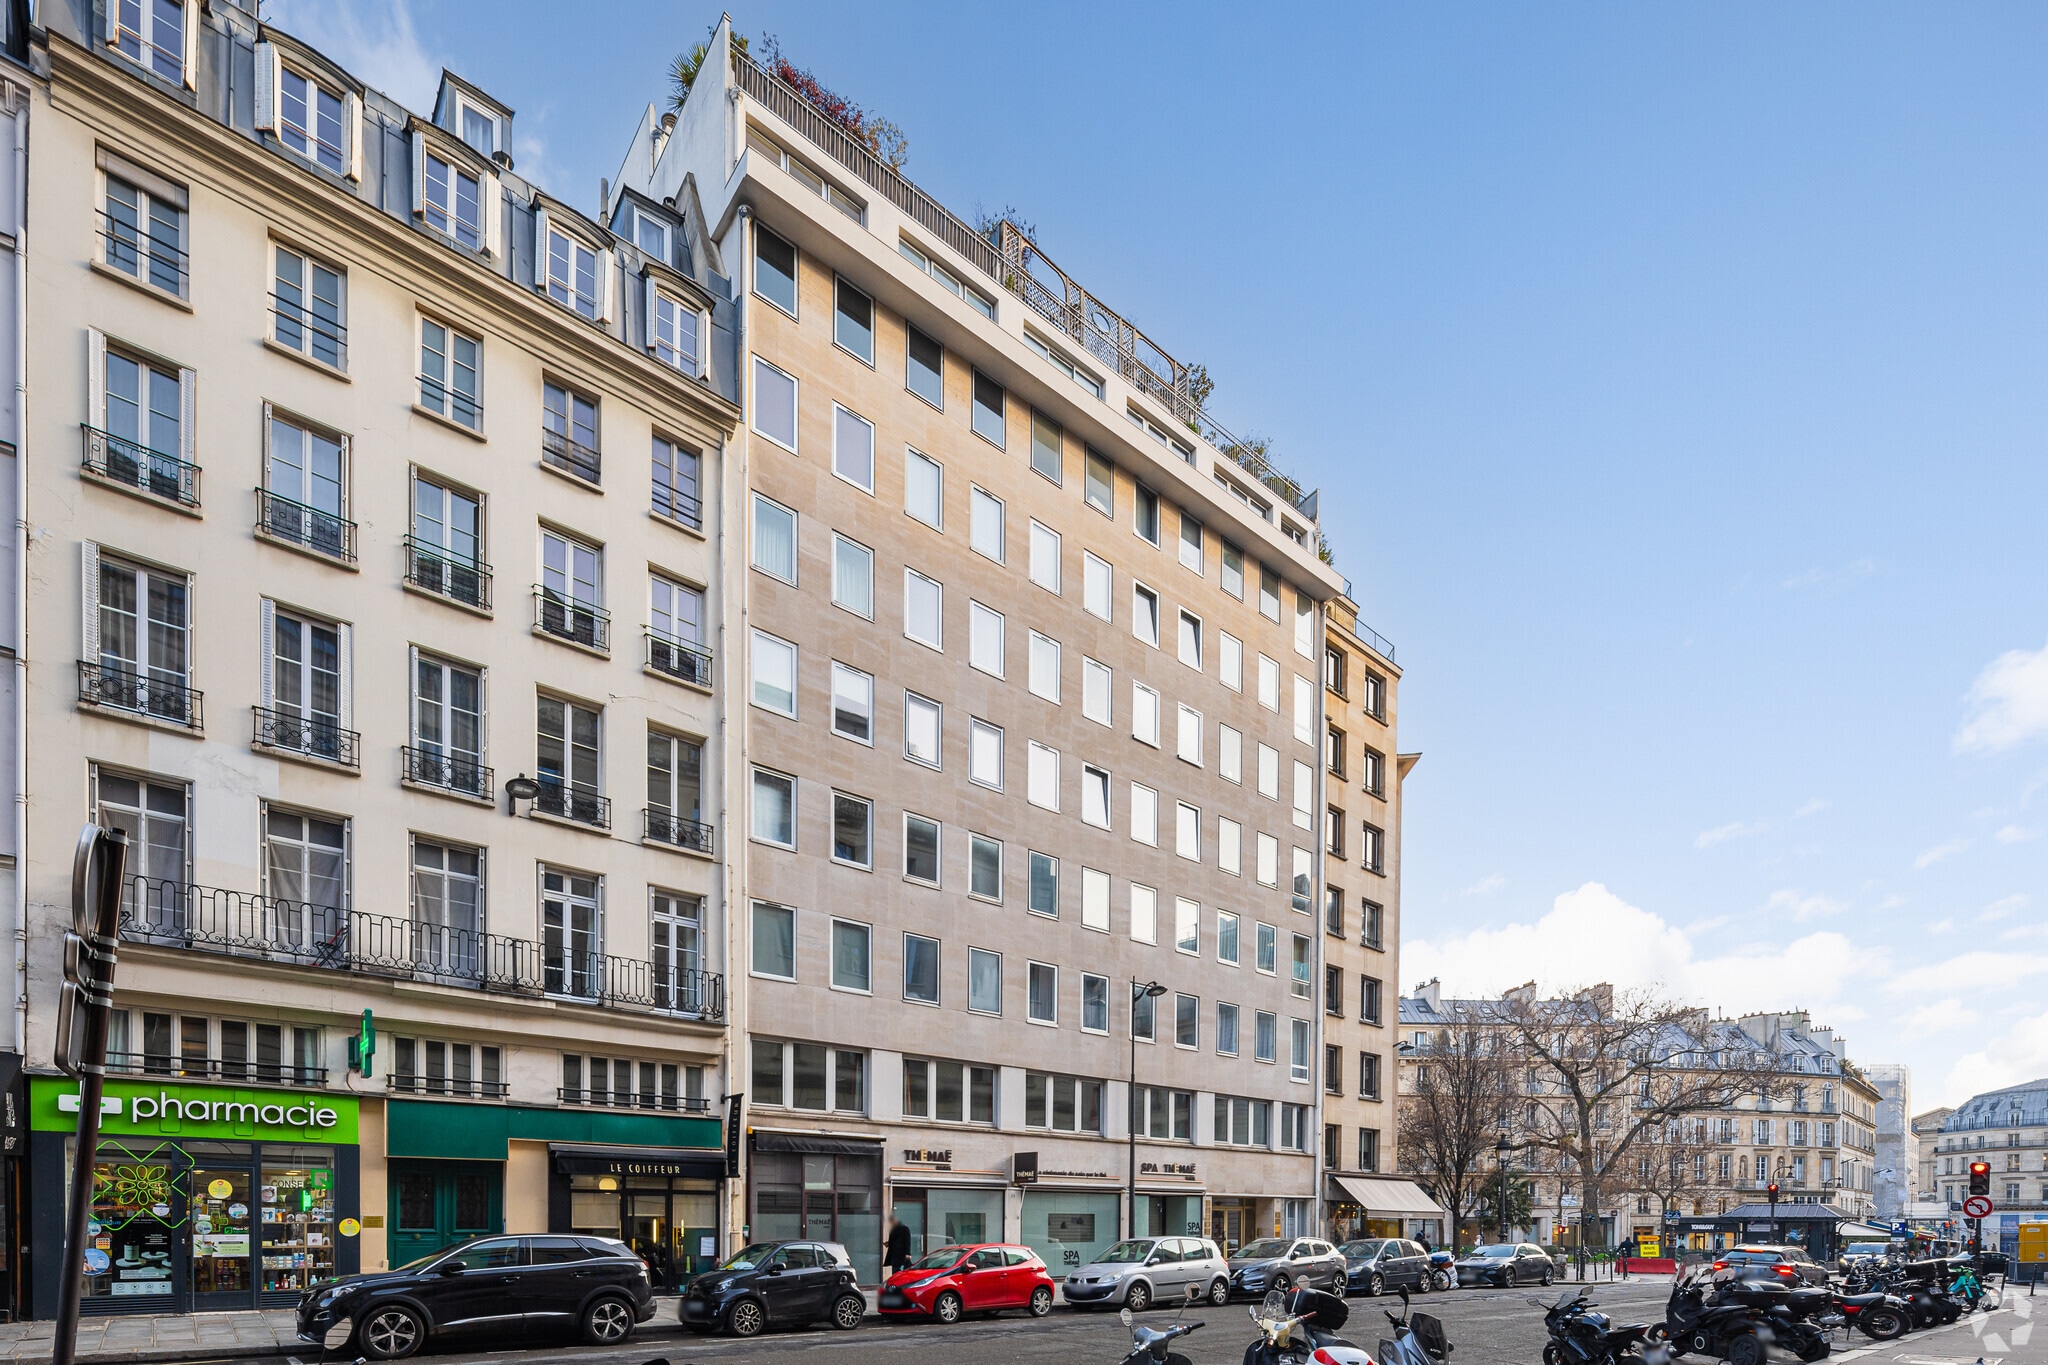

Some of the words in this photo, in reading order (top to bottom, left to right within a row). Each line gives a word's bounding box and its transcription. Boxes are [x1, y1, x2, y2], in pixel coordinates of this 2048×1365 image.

[132, 1091, 338, 1128] pharmacie
[610, 1163, 622, 1172] LE
[628, 1164, 680, 1174] COIFFEUR
[1141, 1162, 1158, 1172] SPA
[1188, 1222, 1200, 1230] SPA
[1064, 1250, 1080, 1260] SPA
